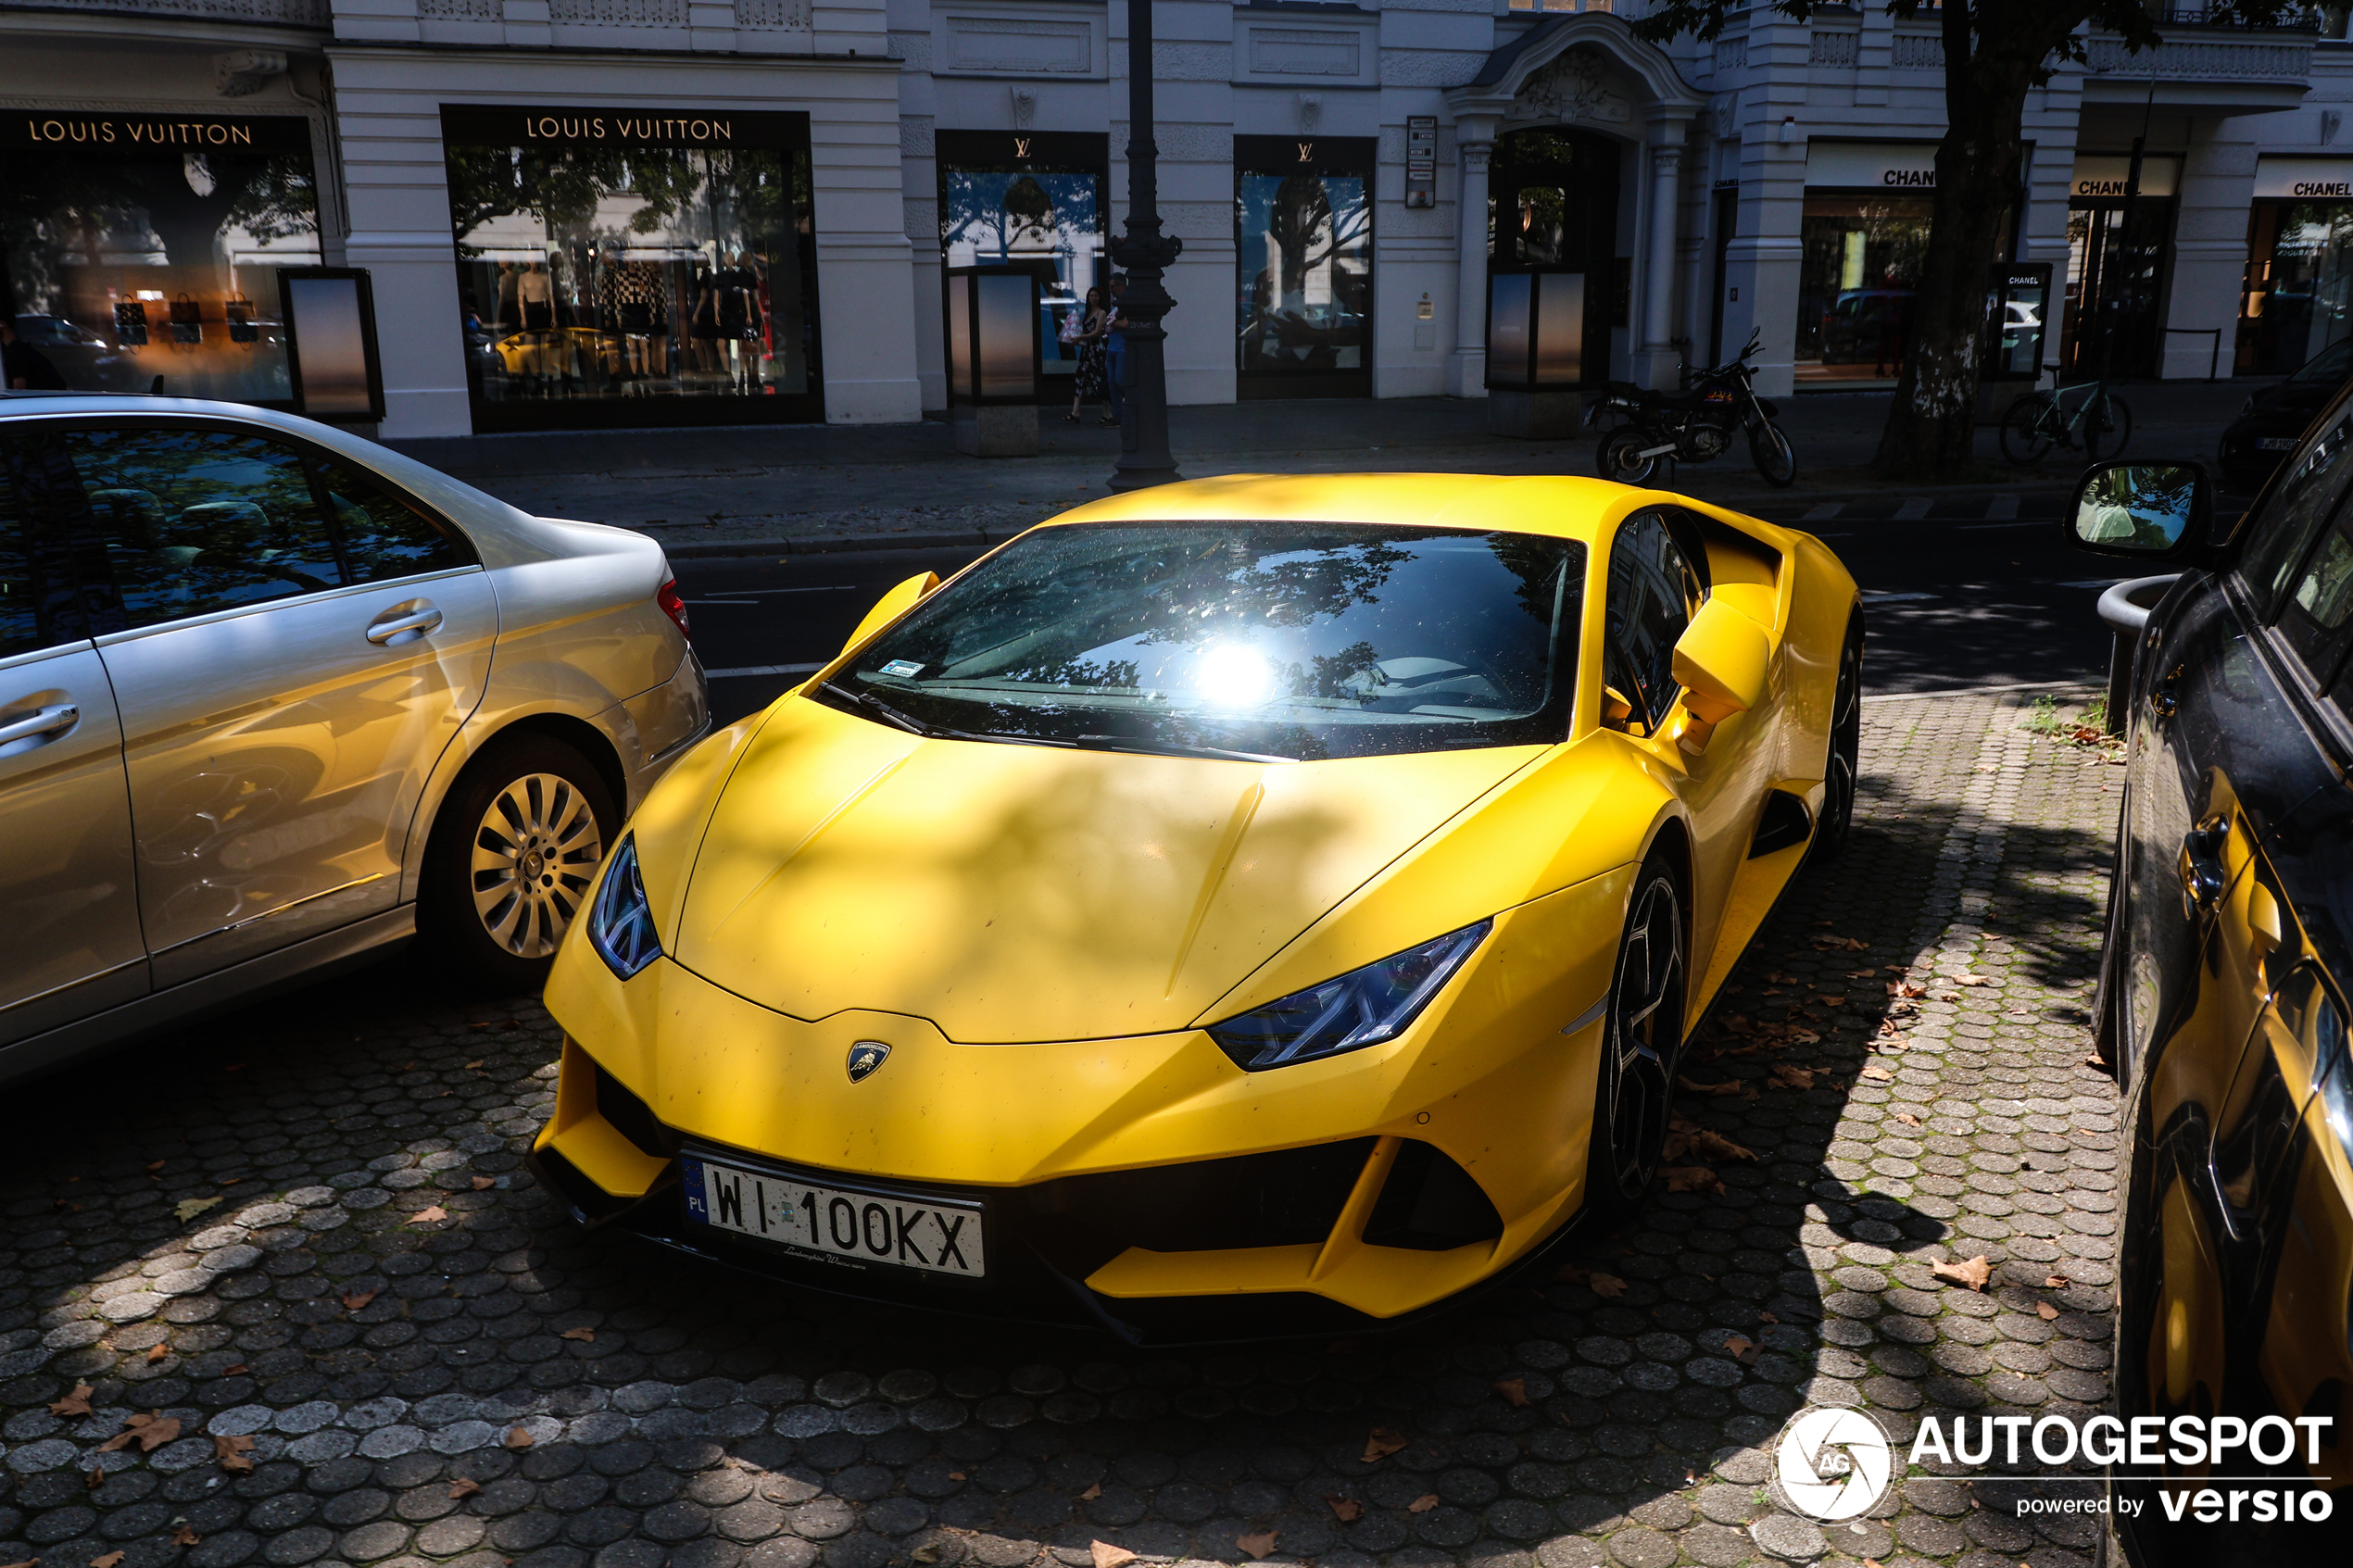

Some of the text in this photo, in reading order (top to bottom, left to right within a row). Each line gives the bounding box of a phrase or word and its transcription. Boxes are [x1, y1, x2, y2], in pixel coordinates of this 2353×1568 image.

[29, 119, 251, 144] LOUIS VUITTON
[527, 117, 731, 140] LOUIS VUITTON
[1715, 179, 1739, 188] CHANEL
[1884, 169, 1935, 185] CHAN
[2078, 181, 2142, 194] CHAN
[2294, 182, 2353, 195] CHANEL
[2008, 276, 2039, 284] CHANEL
[854, 1044, 887, 1053] LAMBORGHINI
[689, 1196, 706, 1214] PL
[713, 1171, 970, 1271] WI 100KX
[784, 1246, 825, 1261] Lamborghini
